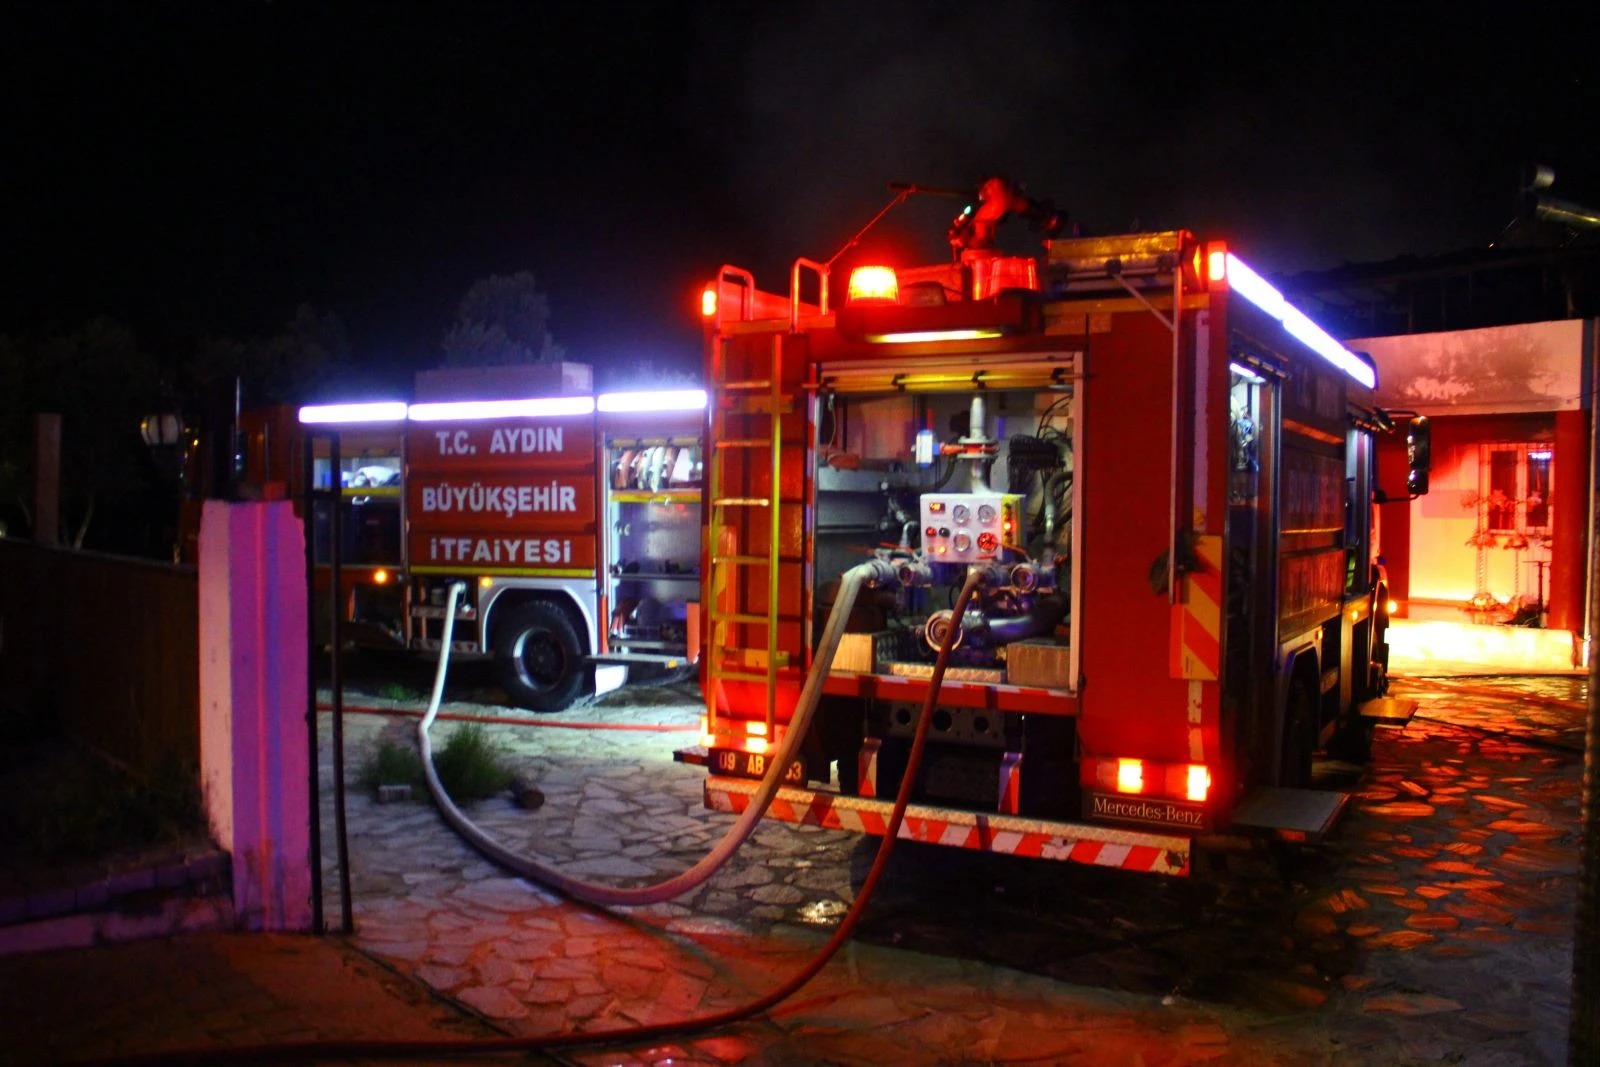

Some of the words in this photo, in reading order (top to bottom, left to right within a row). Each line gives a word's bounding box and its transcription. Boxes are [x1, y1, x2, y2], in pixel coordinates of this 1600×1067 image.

[435, 430, 477, 455] T.C.
[489, 427, 563, 453] AYDIN
[422, 480, 577, 518] BÜYÜKŞEHİR
[720, 751, 736, 771] 09
[1093, 797, 1203, 824] Mercedes-Benz
